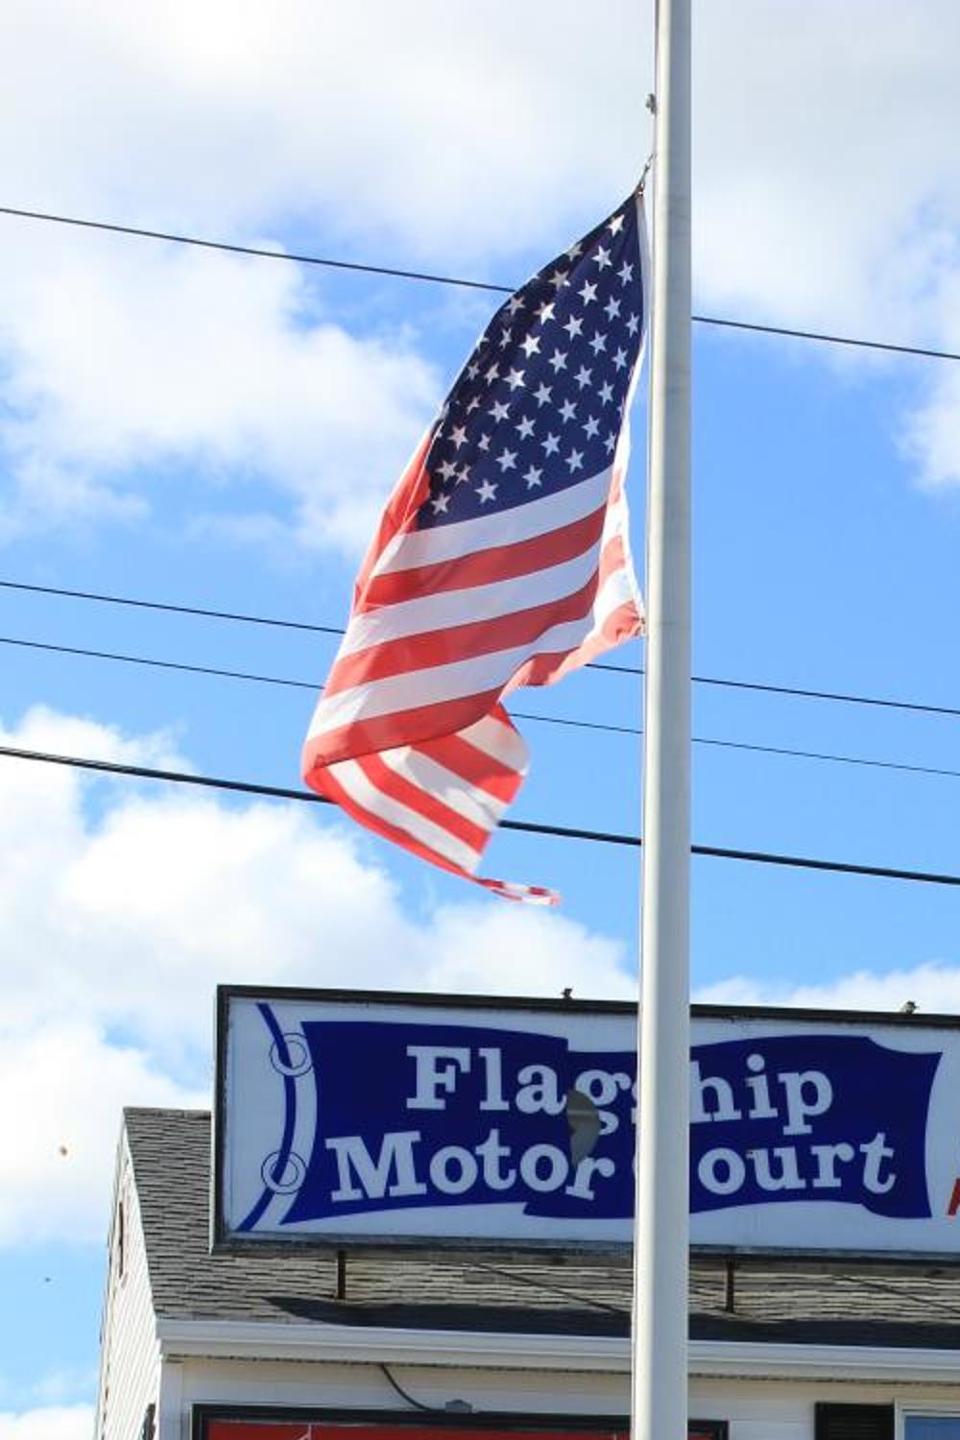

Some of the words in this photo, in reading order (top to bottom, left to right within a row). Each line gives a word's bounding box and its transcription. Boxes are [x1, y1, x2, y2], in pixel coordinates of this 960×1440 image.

[406, 1045, 834, 1137] Flaghip
[325, 1128, 615, 1201] Motor
[633, 1132, 897, 1196] ourt
